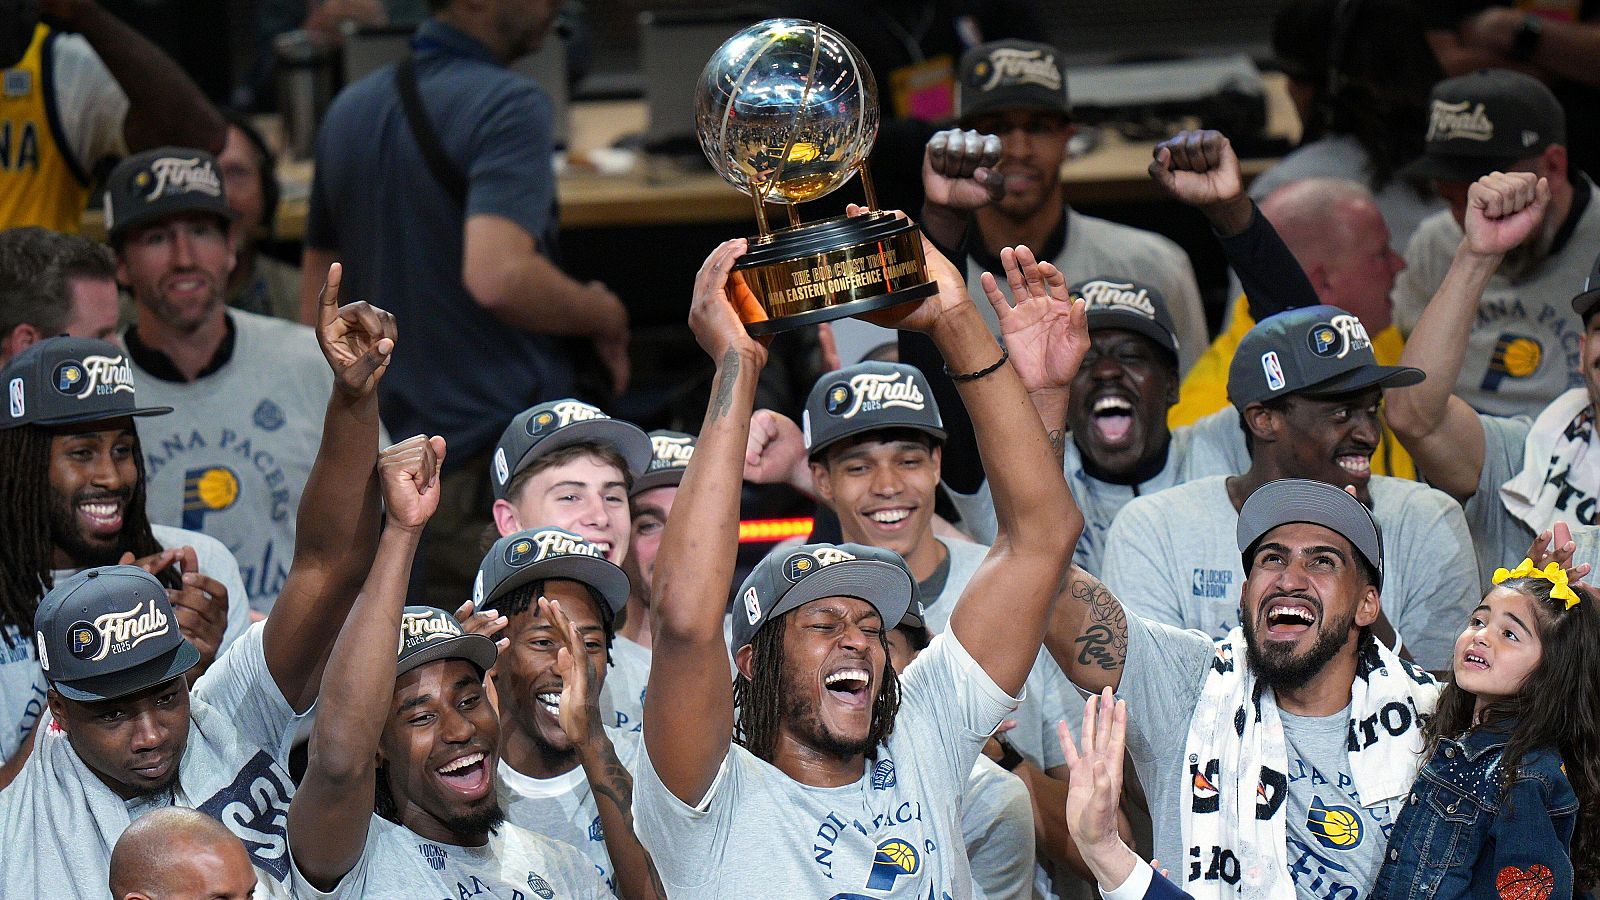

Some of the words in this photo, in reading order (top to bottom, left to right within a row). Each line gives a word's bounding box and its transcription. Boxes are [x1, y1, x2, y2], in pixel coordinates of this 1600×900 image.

[792, 269, 811, 286] THE
[813, 265, 833, 282] BOB
[786, 281, 826, 302] EASTERN
[828, 269, 882, 294] CONFERENCE
[96, 385, 113, 395] 2025
[843, 371, 924, 419] Finals
[862, 401, 881, 412] 2025
[92, 599, 169, 661] Finals
[112, 641, 131, 654] 2025
[405, 635, 426, 648] 2025
